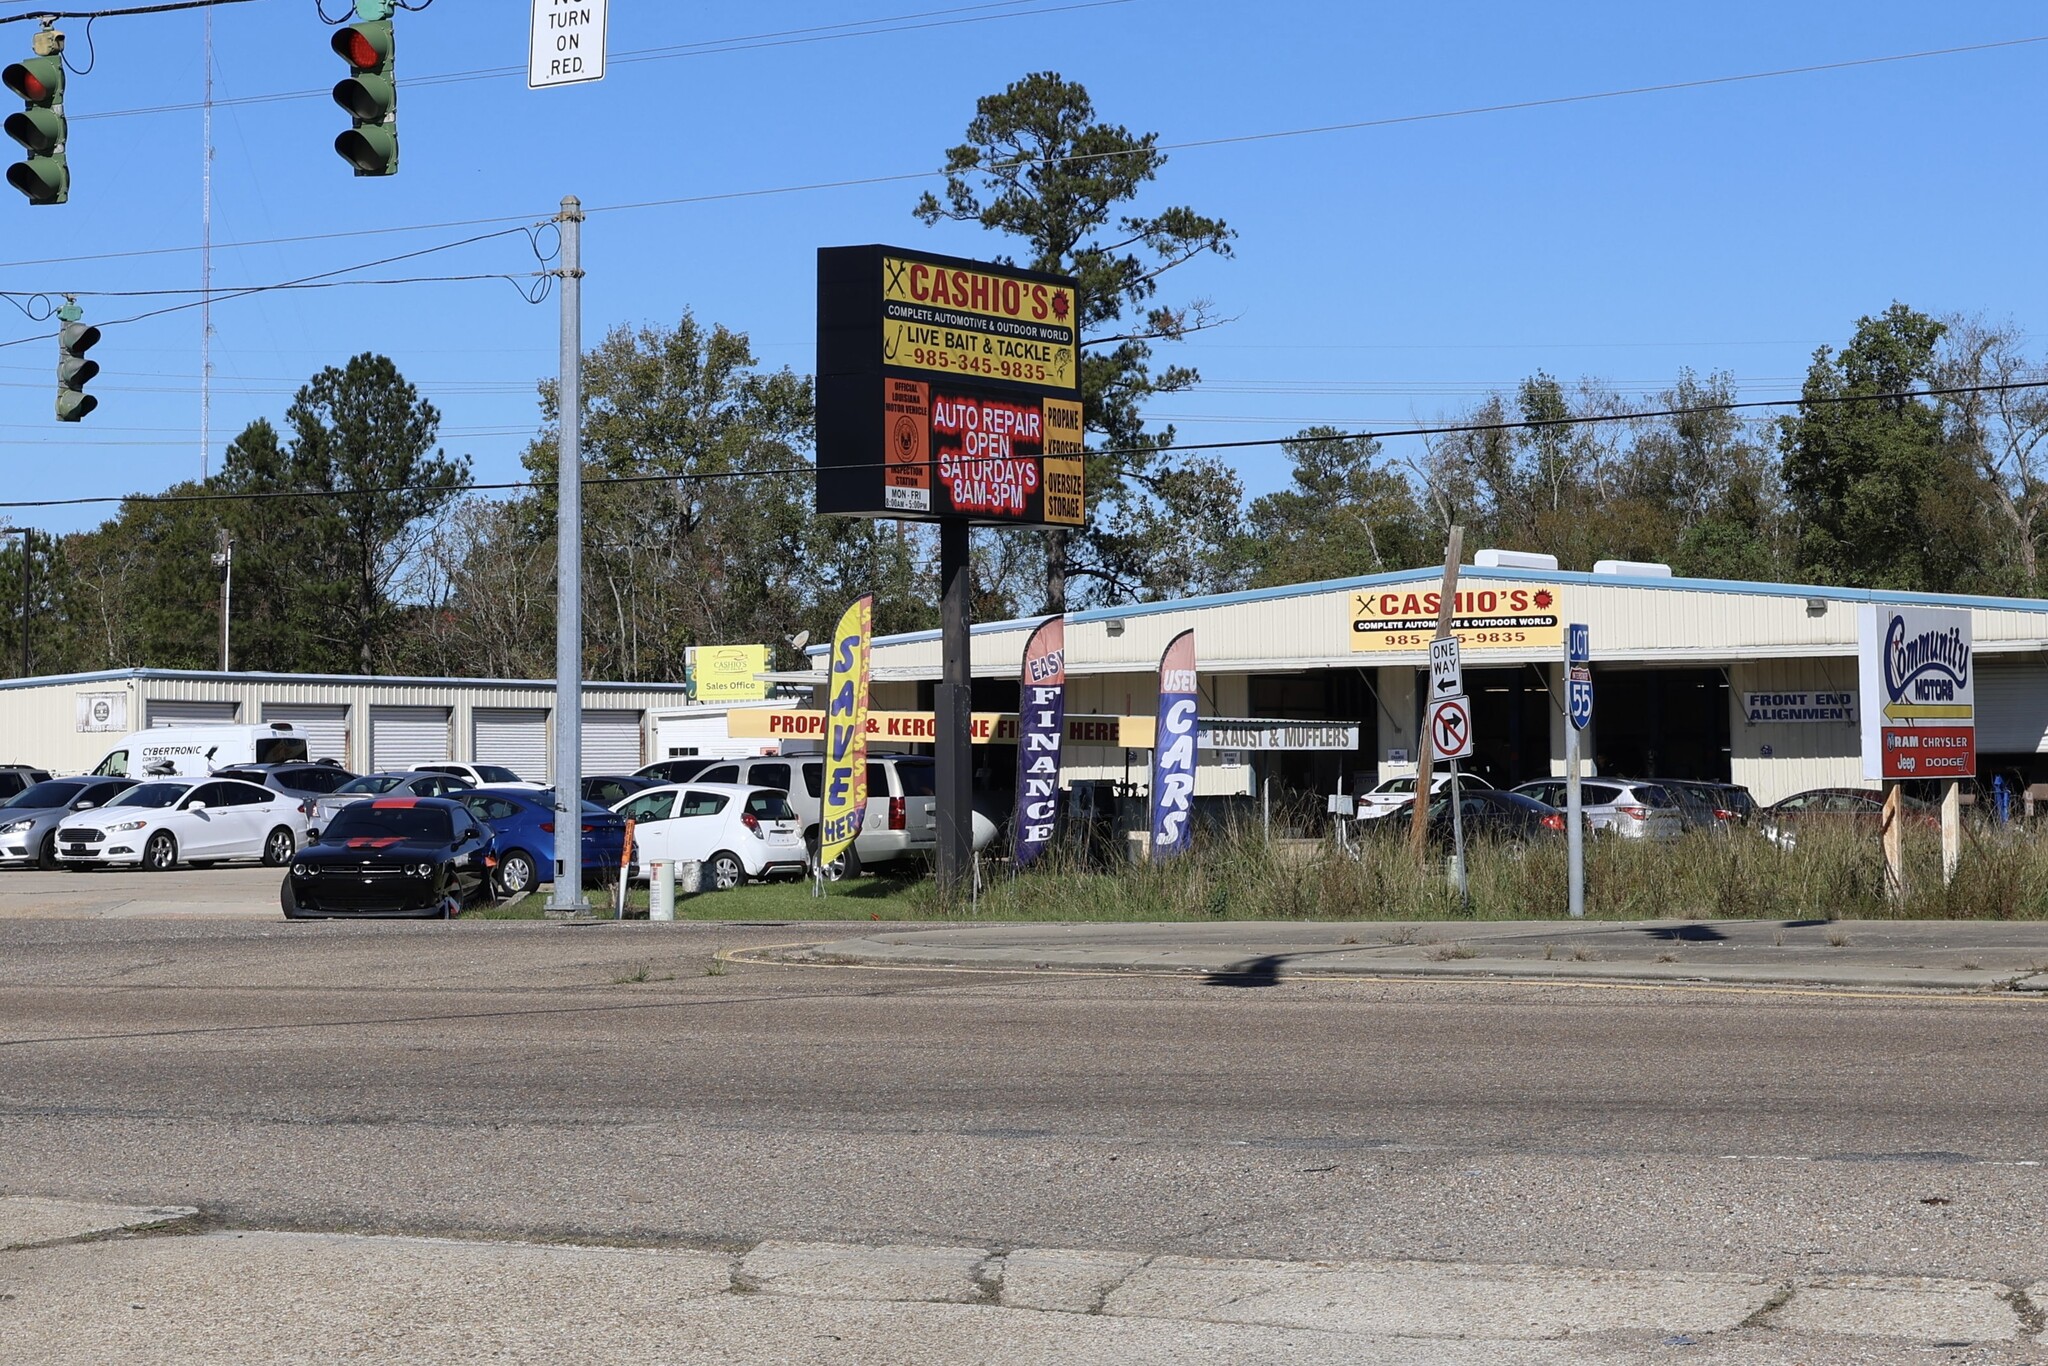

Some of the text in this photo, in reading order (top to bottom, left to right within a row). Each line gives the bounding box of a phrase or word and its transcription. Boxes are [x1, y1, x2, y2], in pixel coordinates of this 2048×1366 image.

[549, 8, 590, 29] TURN
[557, 33, 579, 51] ON
[551, 57, 582, 75] RED
[910, 264, 1048, 320] CASHIO'S
[888, 304, 1069, 341] COMPLETE AUTOMOTIVE & OUTDOOR WORLD
[907, 326, 1051, 362] LIVE BAIT & TACKLE
[892, 392, 920, 404] LOUISIANA
[894, 382, 918, 393] OFFICIAL
[885, 403, 927, 416] MOTOR VEHICLE
[934, 402, 1040, 438] AUTO REPAIR
[1048, 406, 1078, 430] PROPANE
[965, 431, 1009, 459] OPEN
[1048, 439, 1081, 462] KEROSENE
[891, 466, 923, 476] INSPECTION
[940, 453, 1036, 486] SATURDAYS
[895, 476, 918, 486] STATION
[1048, 472, 1081, 496] OVERSIZE
[891, 489, 906, 499] MON
[911, 490, 922, 500] FRI
[954, 479, 1023, 509] 8AM-3PM
[1048, 496, 1080, 518] STORAGE
[1358, 621, 1403, 630] COMPLETE
[1472, 619, 1517, 627] OUTDOOR
[1520, 618, 1553, 626] WORLD
[1433, 643, 1456, 660] ONE
[1570, 630, 1588, 655] JCT
[1433, 659, 1457, 676] WAY
[706, 681, 755, 690] Sales Office
[1164, 669, 1197, 692] USED
[1914, 678, 1954, 702] MOTORS
[1573, 684, 1591, 717] 55
[1750, 694, 1851, 706] FRONT END
[827, 635, 860, 806] SAVE
[1750, 708, 1853, 720] ALIGNMENT
[866, 718, 880, 734] &
[1070, 722, 1119, 740] HERE
[1212, 725, 1264, 748] EXAUST
[1269, 727, 1280, 748] &
[1284, 727, 1350, 748] MUFFLERS
[142, 746, 202, 756] CYBERTRONIC
[1894, 736, 1967, 748] RAM CHRYSLER
[1024, 687, 1061, 842] FINANCE
[1156, 700, 1197, 845] CARS
[1897, 753, 1964, 772] Jeep DODGE
